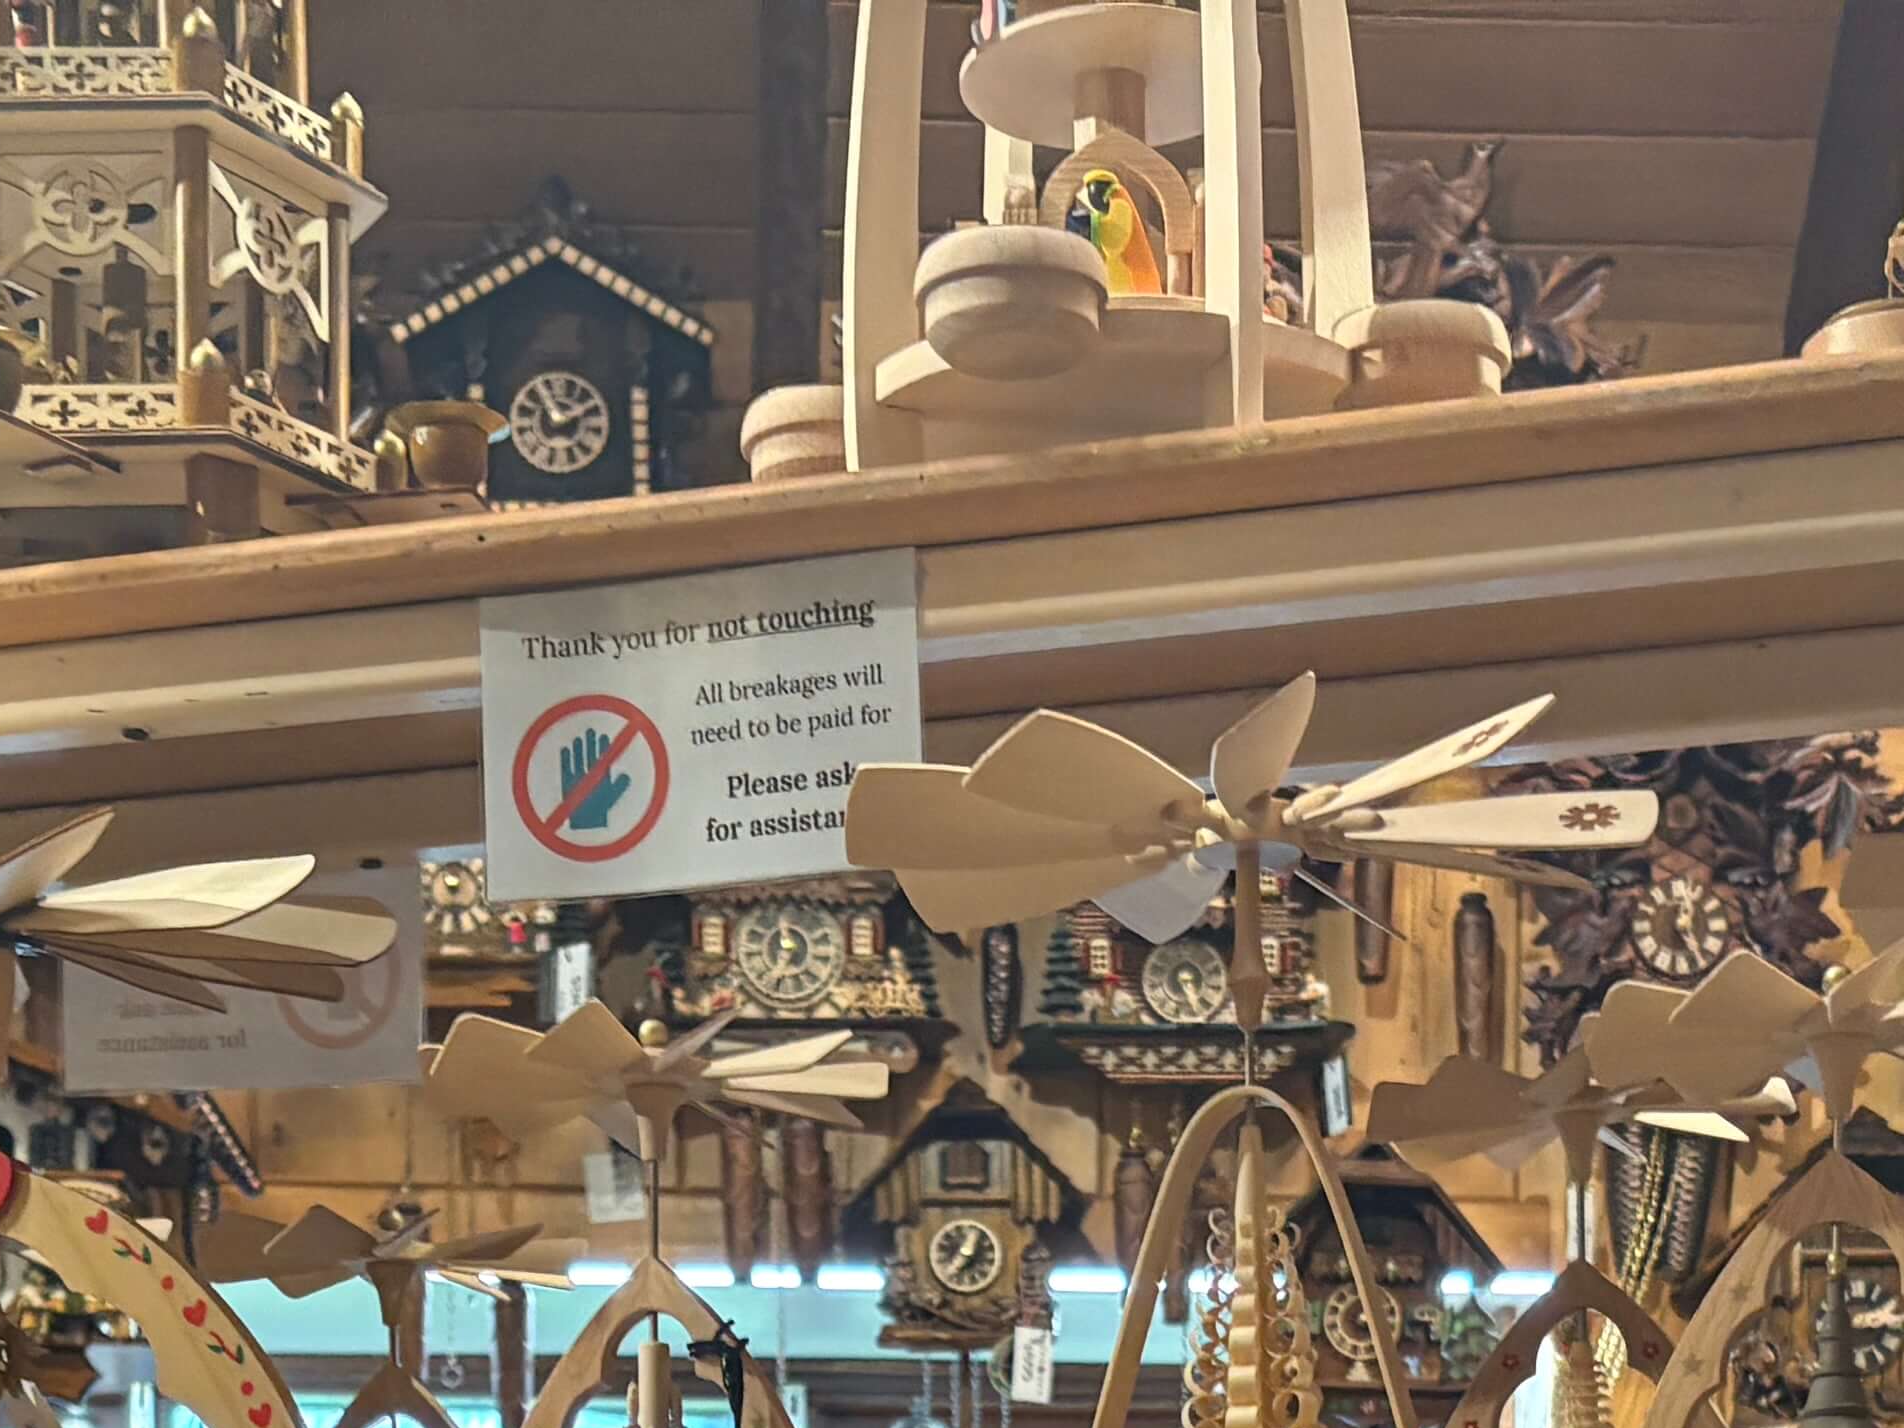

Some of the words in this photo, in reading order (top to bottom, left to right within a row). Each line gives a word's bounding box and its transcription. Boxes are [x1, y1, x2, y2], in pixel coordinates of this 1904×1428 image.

[522, 632, 605, 661] Thank
[611, 630, 656, 660] you
[664, 619, 702, 645] for
[707, 614, 752, 641] not
[757, 598, 876, 635] touching
[694, 681, 724, 706] All
[729, 673, 838, 704] breakages
[842, 664, 884, 689] will
[690, 721, 743, 747] need
[748, 719, 771, 740] to
[775, 712, 802, 737] be
[808, 707, 855, 736] paid
[860, 704, 892, 727] for
[727, 770, 809, 799] Please
[706, 815, 743, 843] for
[749, 805, 846, 836] assista
